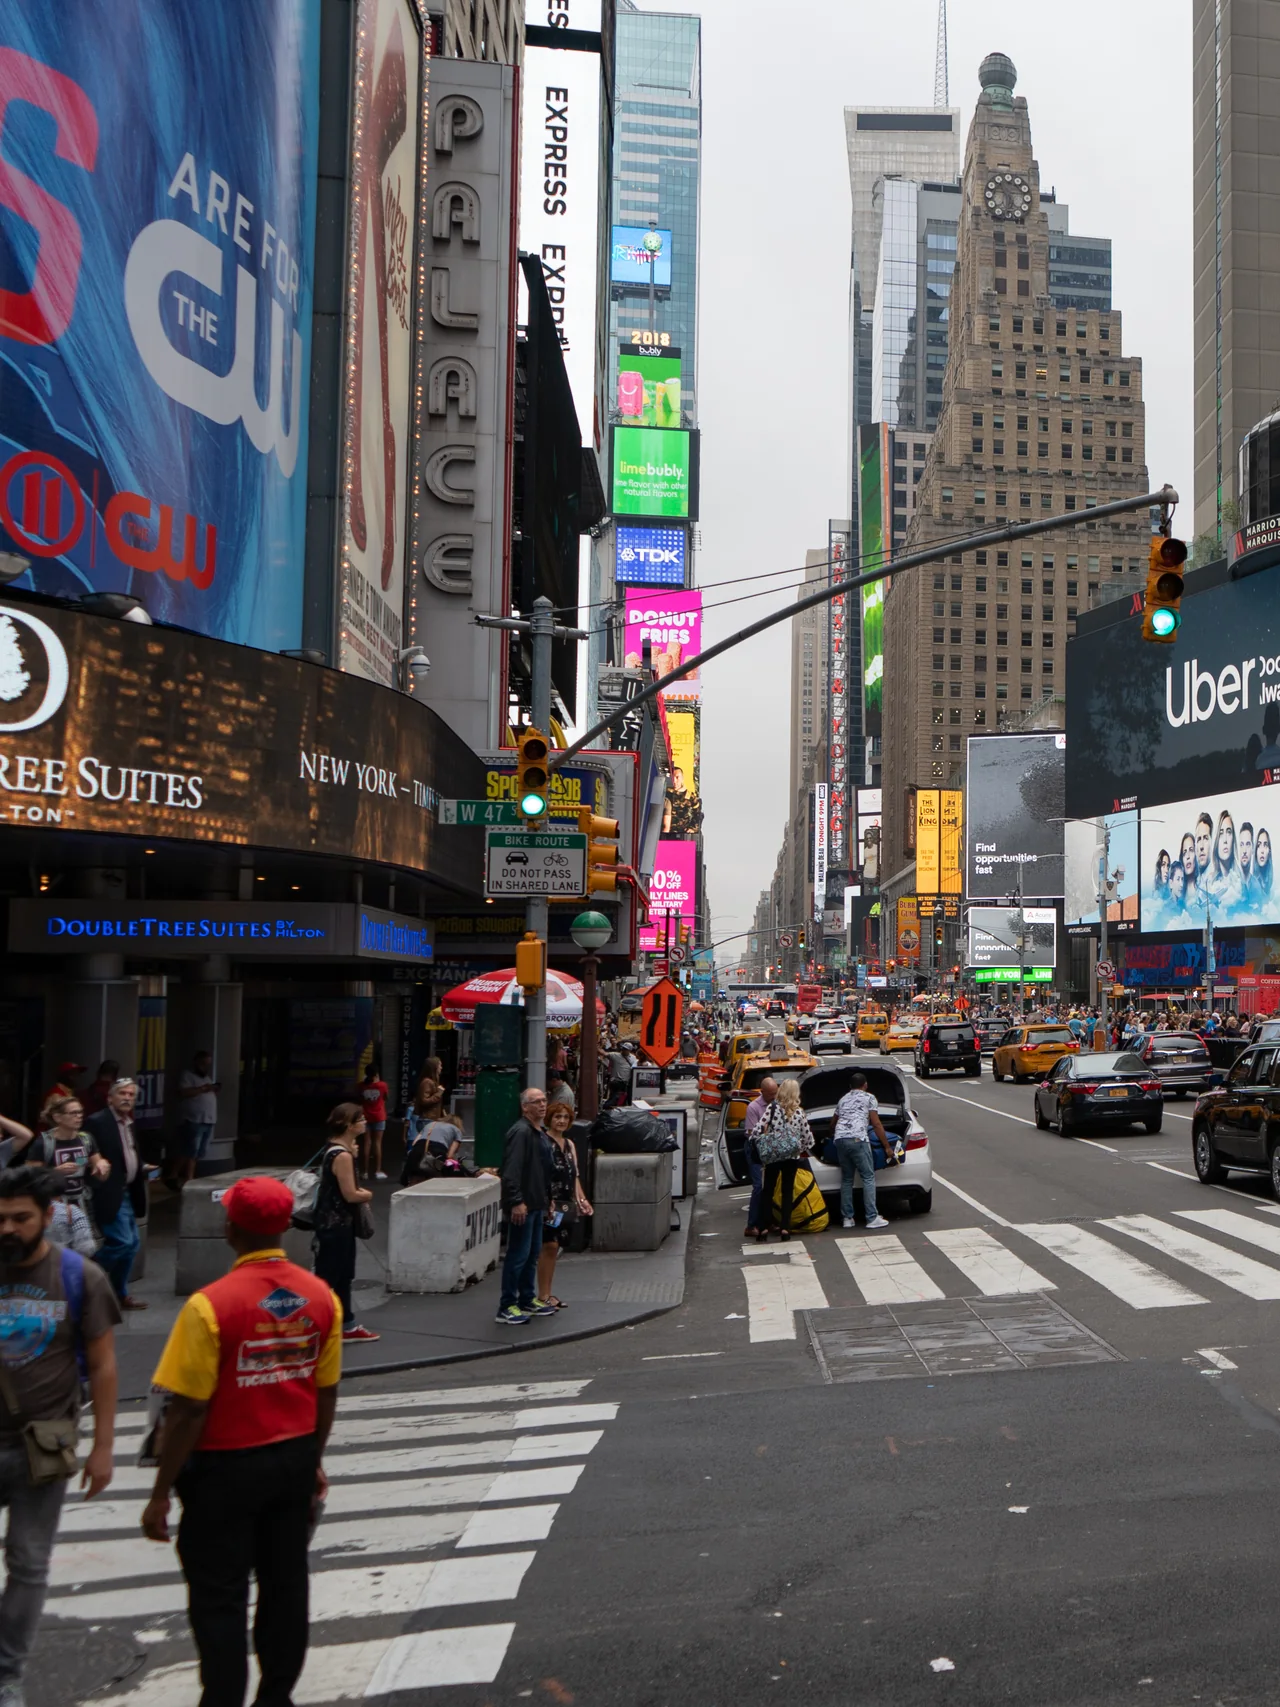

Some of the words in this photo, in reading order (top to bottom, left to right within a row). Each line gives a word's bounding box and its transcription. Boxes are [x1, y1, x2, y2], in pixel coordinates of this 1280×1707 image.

[544, 86, 568, 216] EXPRESS
[168, 152, 254, 254] ARE
[262, 220, 299, 314] FOR
[173, 291, 218, 346] THE
[424, 94, 484, 595] PALACE
[631, 331, 671, 346] 2018
[639, 345, 662, 356] bubly
[624, 487, 651, 496] natural
[629, 480, 650, 489] flavor
[653, 481, 669, 490] with
[671, 482, 687, 491] other
[635, 548, 680, 564] TDK
[629, 609, 698, 627] DONUT
[640, 628, 690, 644] FRIES
[1166, 658, 1255, 728] Uber
[300, 751, 350, 787] NEW
[356, 762, 398, 799] YORK
[76, 757, 203, 809] SUITES
[461, 804, 476, 821] W
[484, 804, 503, 821] 47
[920, 807, 935, 815] LION
[919, 815, 937, 827] KING
[505, 836, 530, 846] BIKE
[535, 836, 570, 847] ROUTE
[975, 843, 996, 852] Find
[975, 853, 1037, 865] opportunities
[502, 868, 516, 878] DO
[520, 868, 541, 878] NOT
[545, 869, 571, 879] PASS
[975, 866, 993, 874] fast
[491, 881, 501, 891] IN
[504, 881, 547, 891] SHARED
[551, 881, 580, 892] LANE
[664, 892, 688, 900] LINES
[275, 929, 325, 938] HILTON
[463, 984, 502, 993] BROWN
[403, 997, 412, 1037] MONEY
[546, 1014, 579, 1023] BROWN
[402, 1041, 412, 1105] EXCHANGE
[469, 1201, 498, 1250] NYPD
